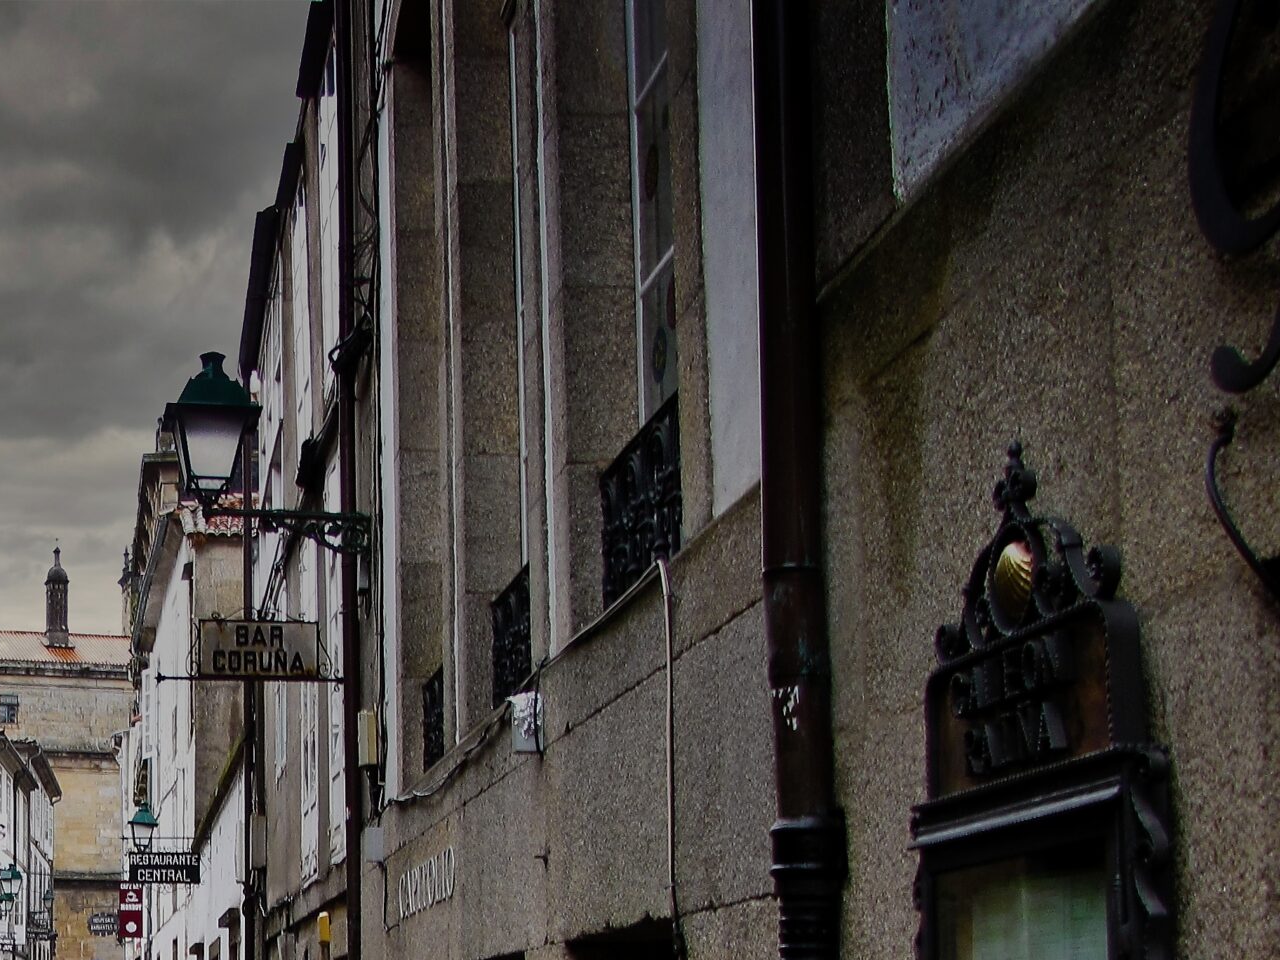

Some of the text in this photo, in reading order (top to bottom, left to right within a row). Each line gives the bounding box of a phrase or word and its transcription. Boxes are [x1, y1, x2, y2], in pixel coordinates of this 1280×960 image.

[235, 625, 284, 647] BAR
[212, 648, 305, 673] CORUÑA
[129, 853, 199, 866] RESTAURANTE
[137, 868, 191, 882] CENTRAL
[399, 846, 455, 919] CAPITOLIO
